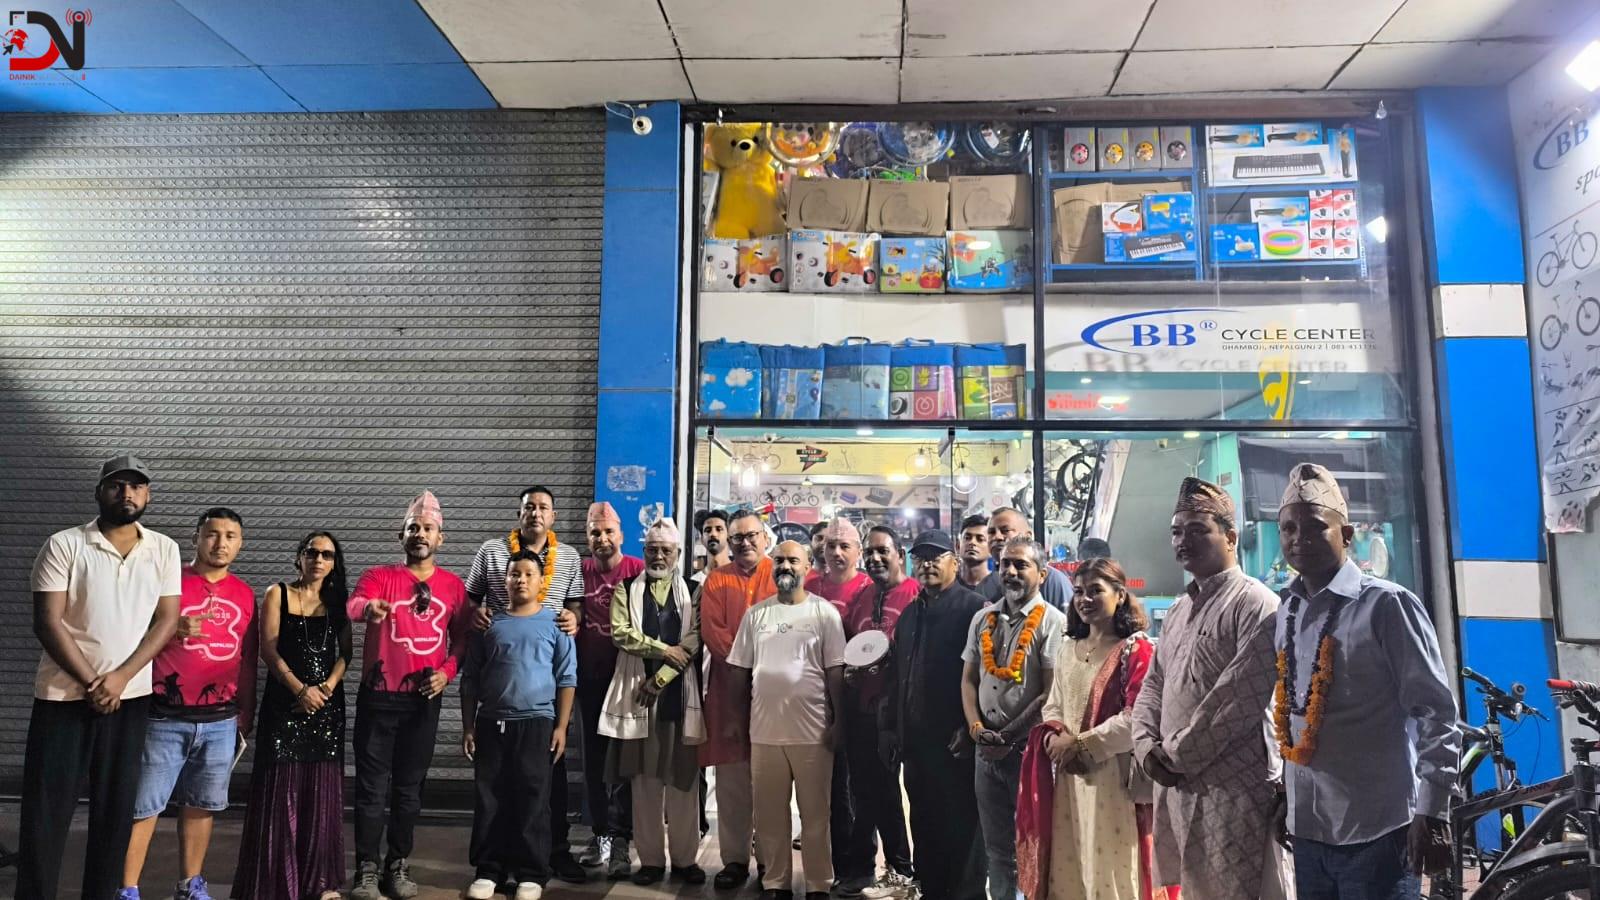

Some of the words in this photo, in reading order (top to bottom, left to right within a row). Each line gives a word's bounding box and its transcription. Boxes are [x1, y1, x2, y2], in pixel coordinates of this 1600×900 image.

[1557, 119, 1589, 158] BB
[1131, 323, 1197, 347] BB
[1221, 328, 1288, 341] CYCLE
[1293, 328, 1376, 340] CENTER
